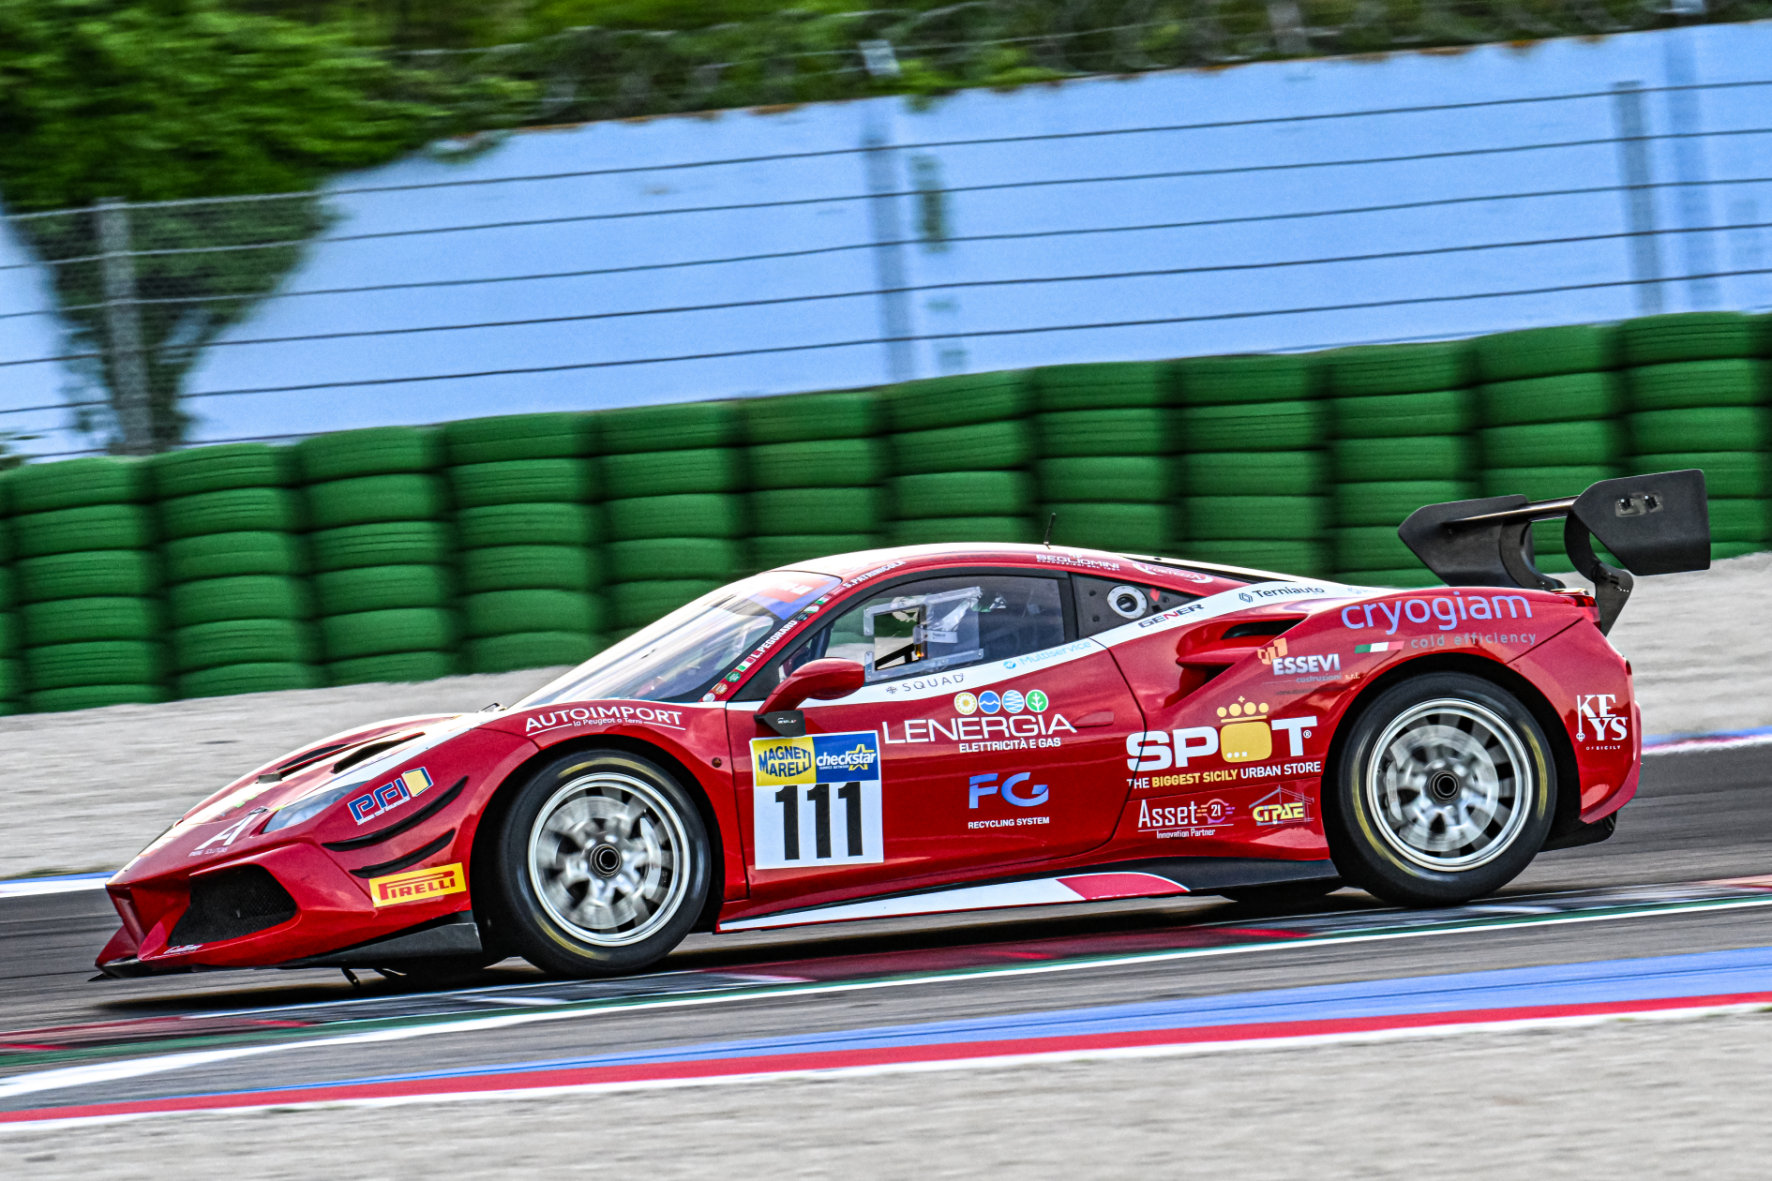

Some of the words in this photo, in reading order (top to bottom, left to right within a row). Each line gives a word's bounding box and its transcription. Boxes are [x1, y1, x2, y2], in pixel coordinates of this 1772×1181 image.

[1252, 586, 1325, 598] Terniauto
[1138, 603, 1204, 629] GENER
[1341, 591, 1532, 635] cryogiam
[1411, 635, 1445, 649] cold
[1454, 632, 1536, 645] efficiency
[1272, 653, 1341, 675] ESSEVI
[902, 673, 964, 692] SQUAD
[525, 706, 682, 732] AUTOIMPORT
[882, 714, 1078, 744] LENERGIA
[758, 746, 812, 762] MAGNETI
[959, 738, 1028, 753] ELETTRICITÀ
[1030, 739, 1037, 748] E
[1038, 737, 1061, 748] GAS
[758, 761, 812, 777] MARELLI
[816, 751, 876, 767] checkstar
[1126, 778, 1150, 789] THE
[1152, 772, 1200, 788] BIGGEST
[1202, 769, 1238, 783] SICILY
[1240, 765, 1281, 779] URBAN
[1284, 761, 1321, 775] STORE
[969, 772, 1049, 809] FG
[775, 781, 863, 861] 111
[968, 819, 1015, 829] RECYCLING
[1016, 816, 1050, 826] SYSTEM
[1137, 799, 1198, 828] Asset
[1211, 804, 1221, 817] 21
[1156, 829, 1189, 839] Innovation
[1190, 827, 1215, 837] Partner
[378, 870, 455, 900] PIRELLI
